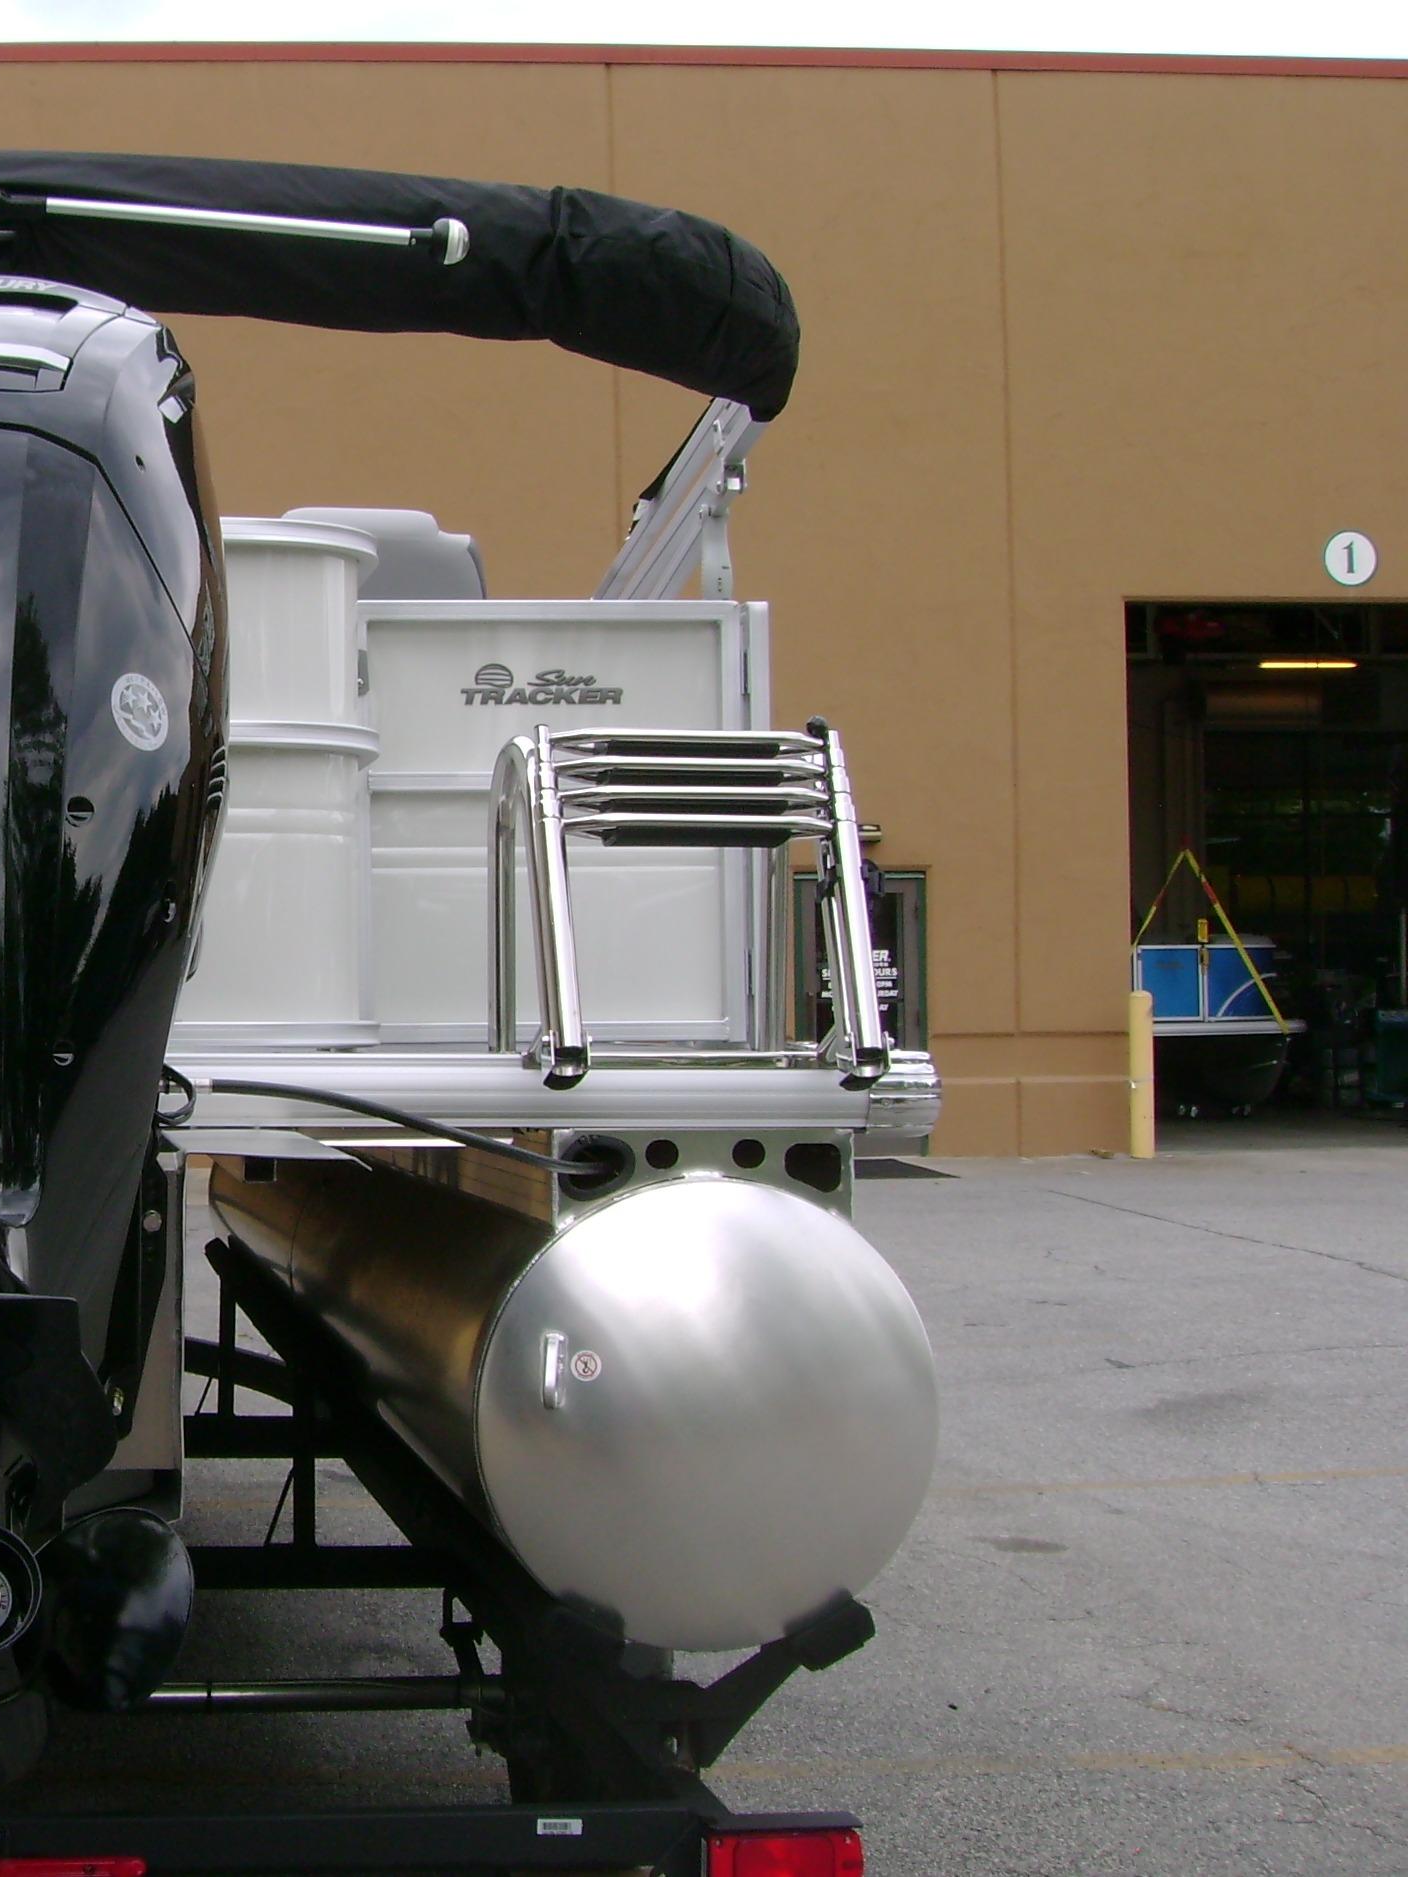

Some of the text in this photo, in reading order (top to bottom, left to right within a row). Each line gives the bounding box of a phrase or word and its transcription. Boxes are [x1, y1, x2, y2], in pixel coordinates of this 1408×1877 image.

[1342, 540, 1355, 574] 1
[527, 669, 597, 687] Sun
[460, 687, 624, 706] TRACKER
